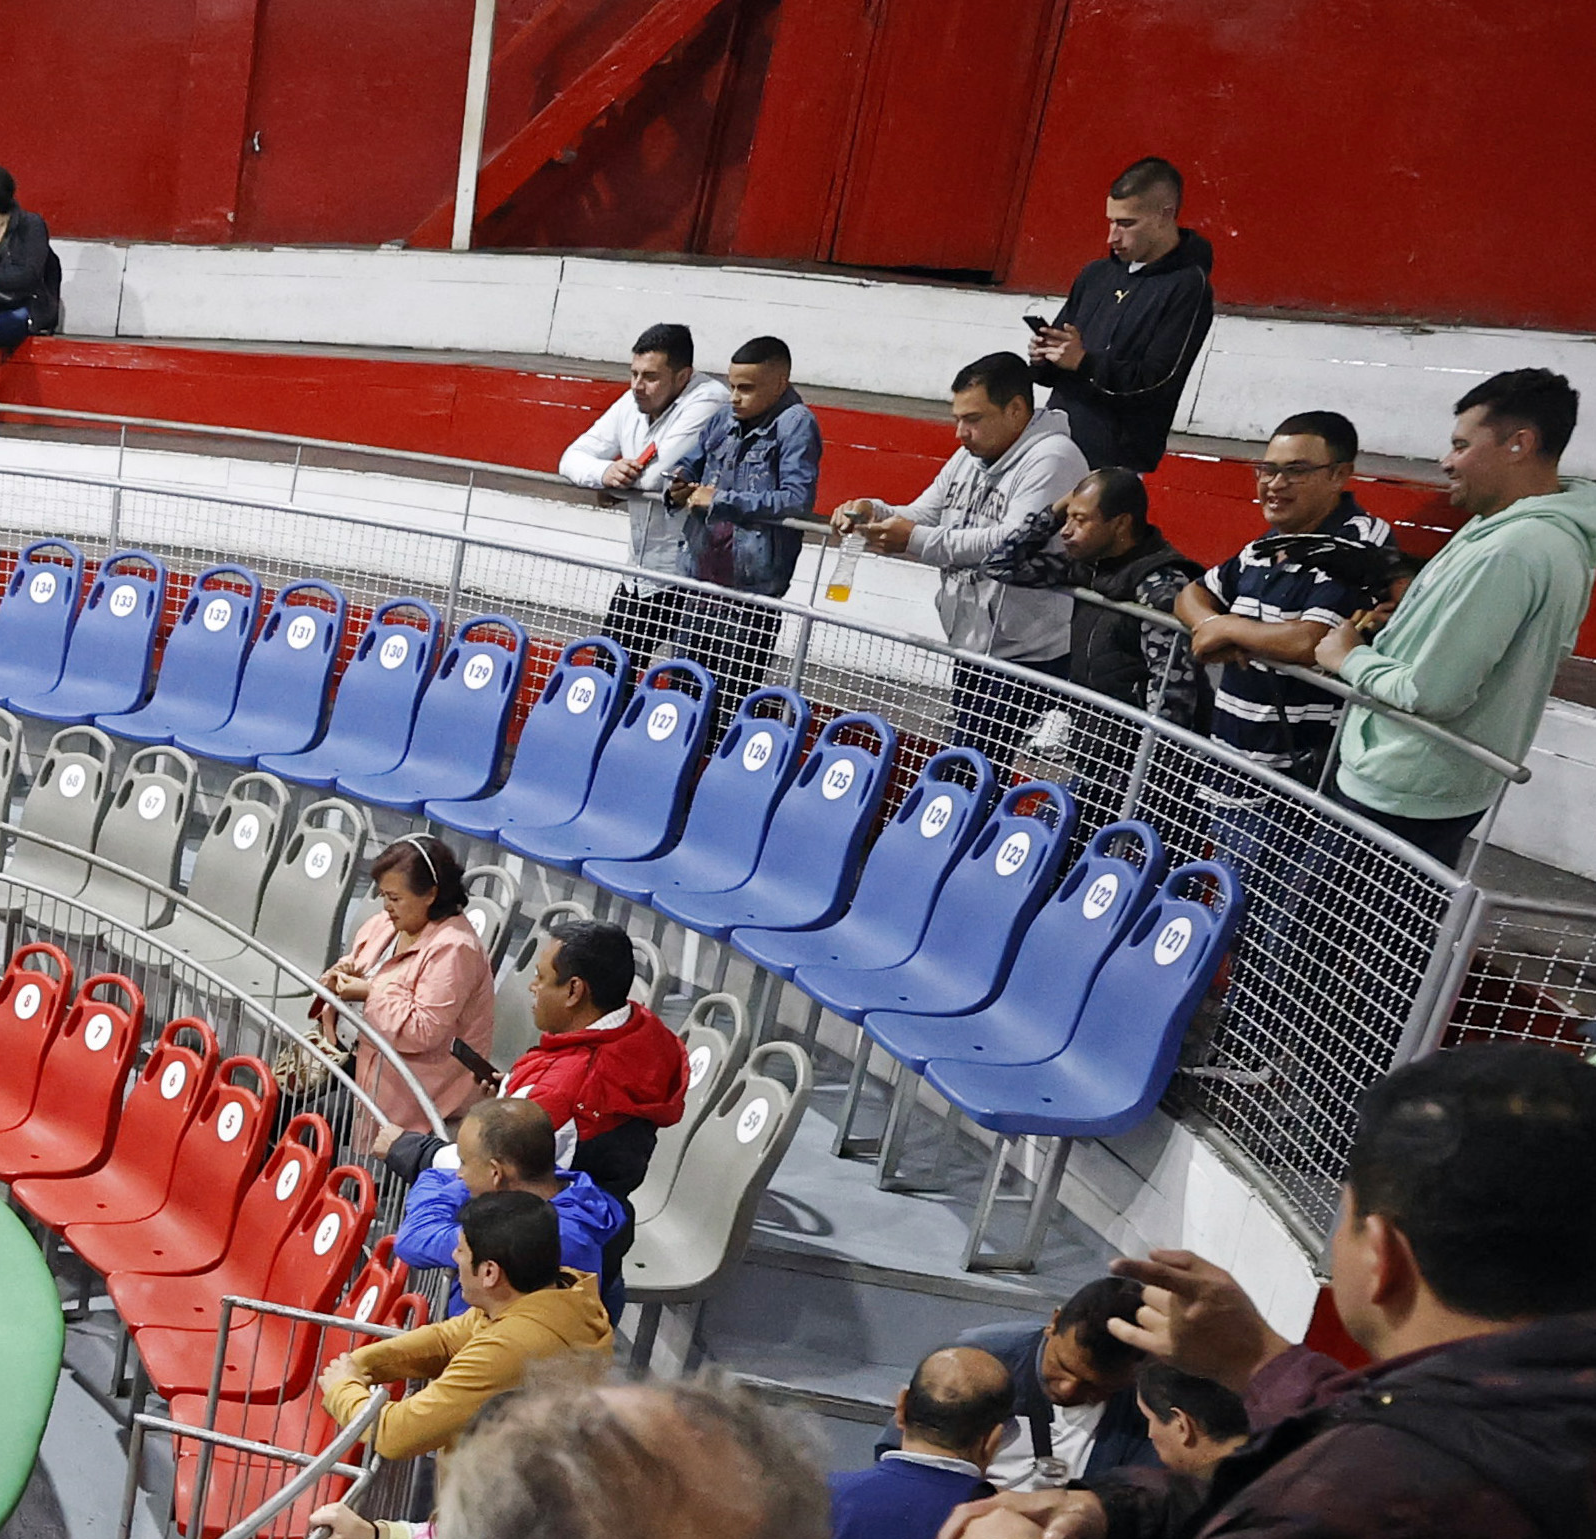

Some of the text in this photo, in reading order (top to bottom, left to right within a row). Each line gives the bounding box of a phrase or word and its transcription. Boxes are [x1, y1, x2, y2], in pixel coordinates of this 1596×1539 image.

[34, 581, 53, 594] 134
[114, 594, 134, 609] 133
[208, 607, 228, 622] 132
[292, 624, 311, 640] 131
[384, 643, 404, 660] 130
[468, 663, 490, 680] 129
[572, 686, 592, 704] 128
[652, 712, 675, 730] 127
[748, 742, 767, 761] 126
[65, 774, 80, 788] 68
[827, 770, 850, 790] 125
[144, 795, 161, 810] 67
[926, 805, 948, 827] 124
[239, 825, 252, 840] 66
[311, 853, 326, 869] 65
[1001, 842, 1025, 866] 123
[1089, 883, 1113, 908] 122
[1161, 927, 1186, 953] 121
[23, 994, 32, 1008] 8
[94, 1025, 104, 1039] 7
[169, 1073, 177, 1088] 6
[225, 1114, 235, 1130] 5
[743, 1110, 761, 1131] 59
[284, 1172, 293, 1187] 4
[321, 1226, 332, 1242] 3
